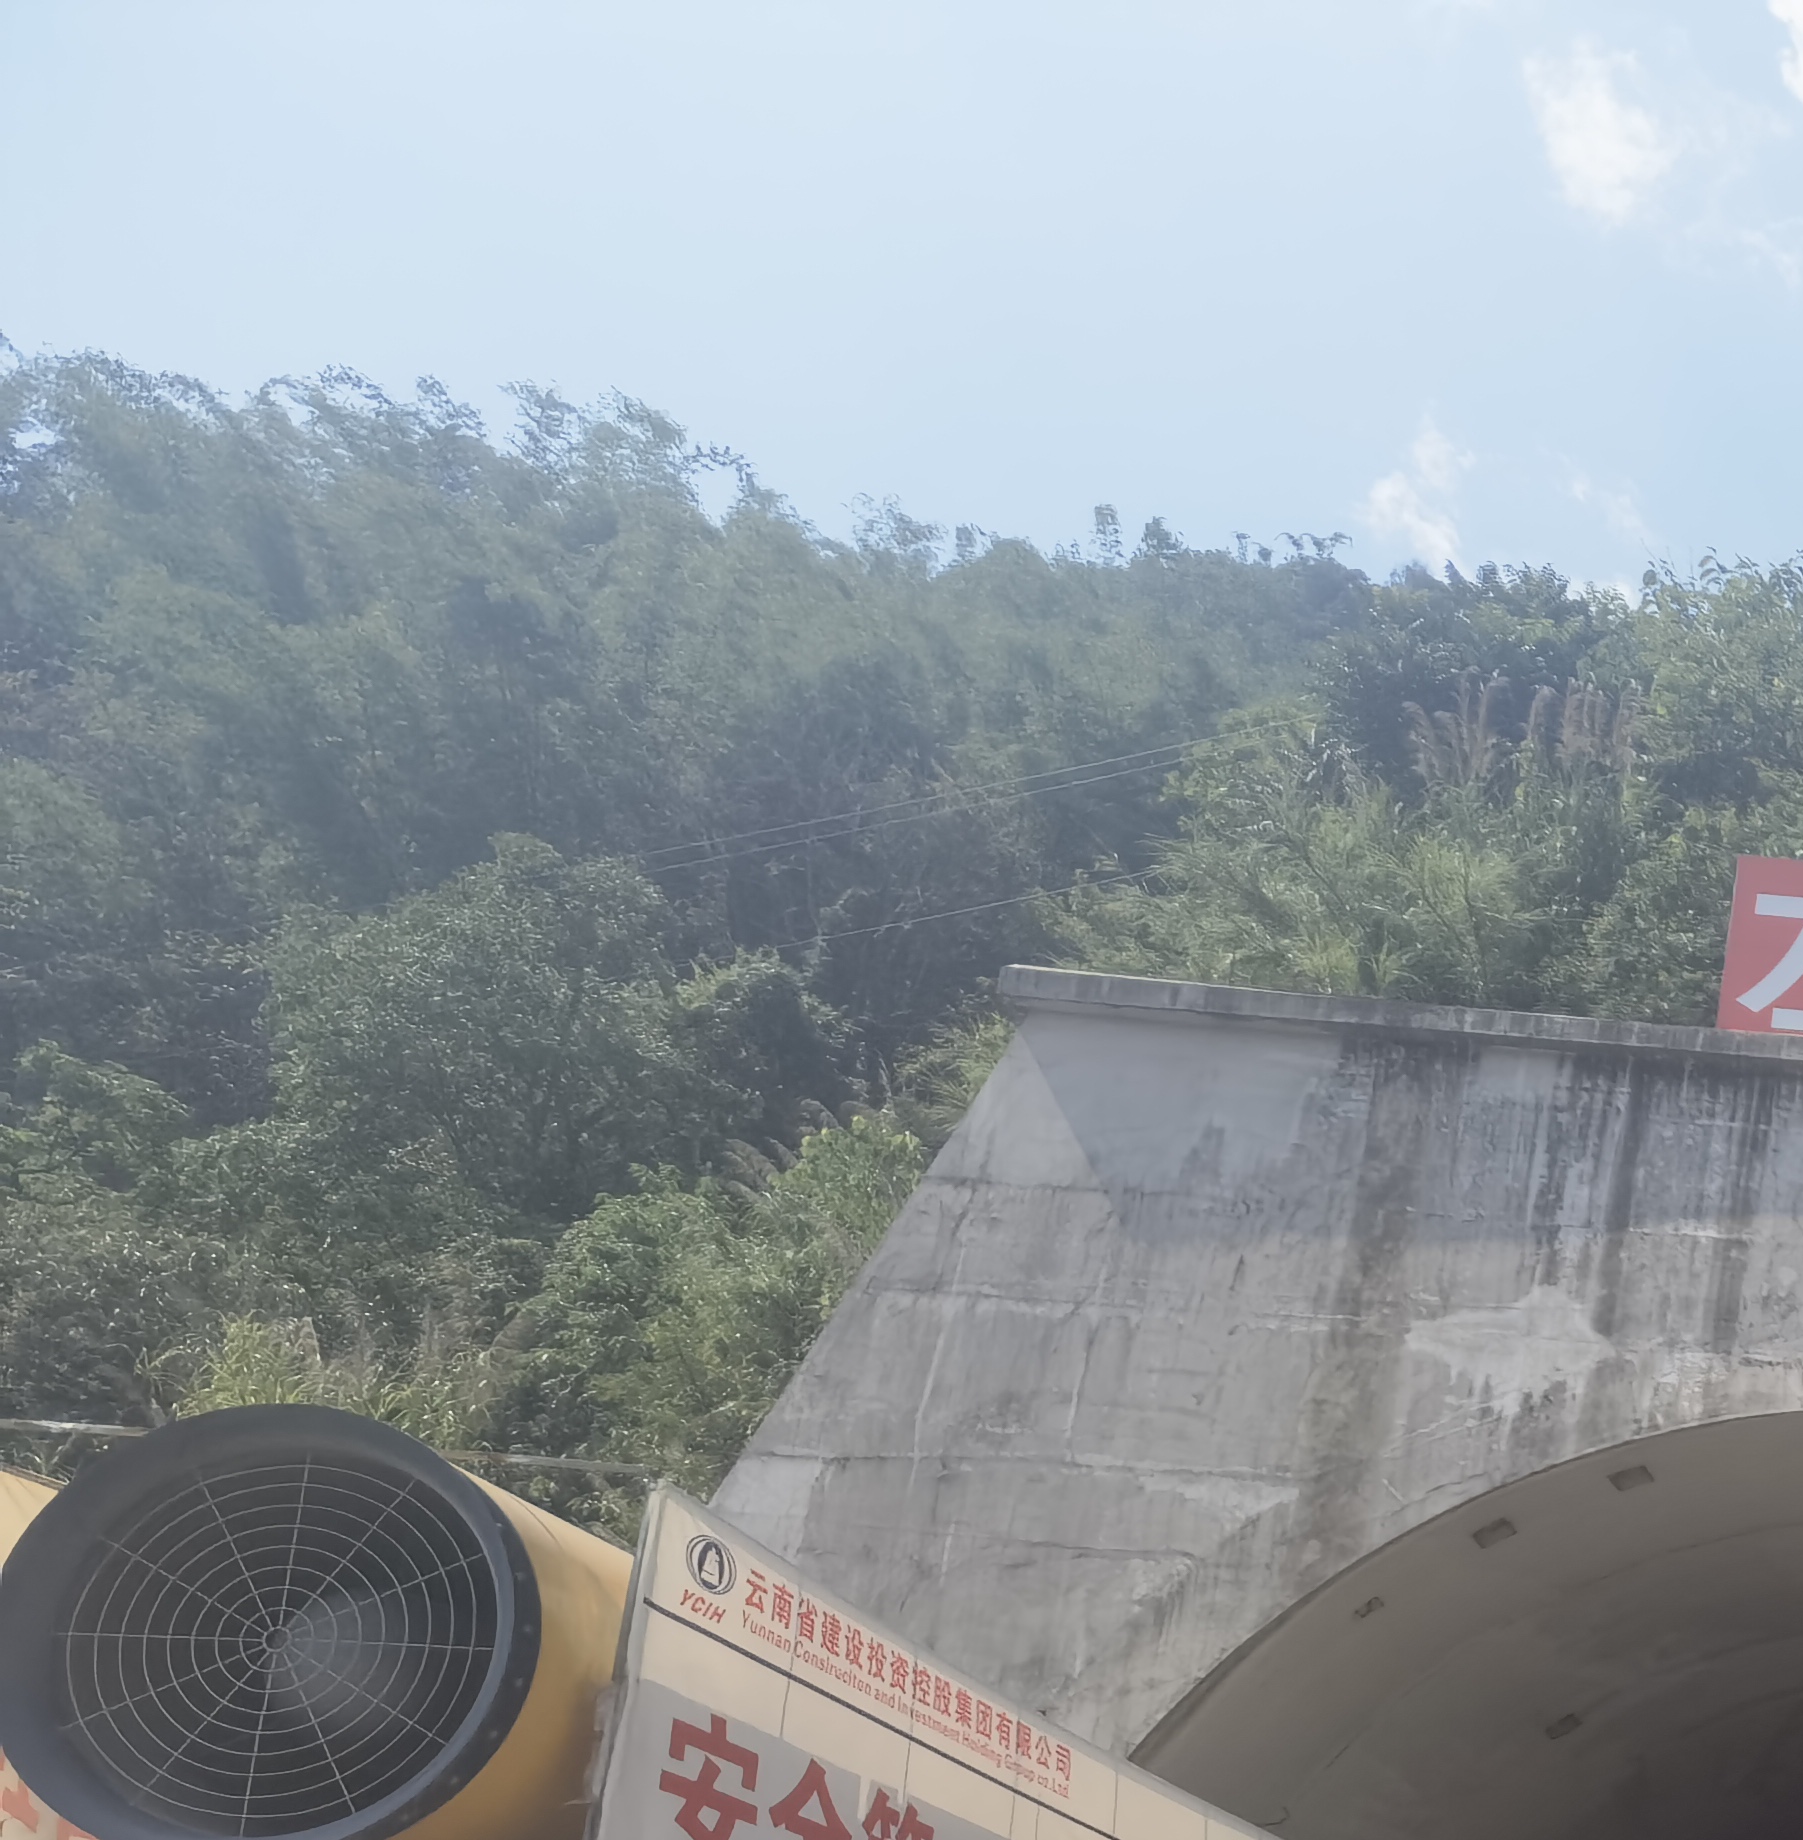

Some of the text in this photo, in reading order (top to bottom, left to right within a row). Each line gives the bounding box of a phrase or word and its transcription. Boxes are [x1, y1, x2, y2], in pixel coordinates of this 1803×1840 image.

[679, 1589, 727, 1624] YCIH
[742, 1610, 791, 1653] Yunnan
[874, 1688, 896, 1709] and
[744, 1568, 1072, 1782] 云南省建设投资控股集团有限公司
